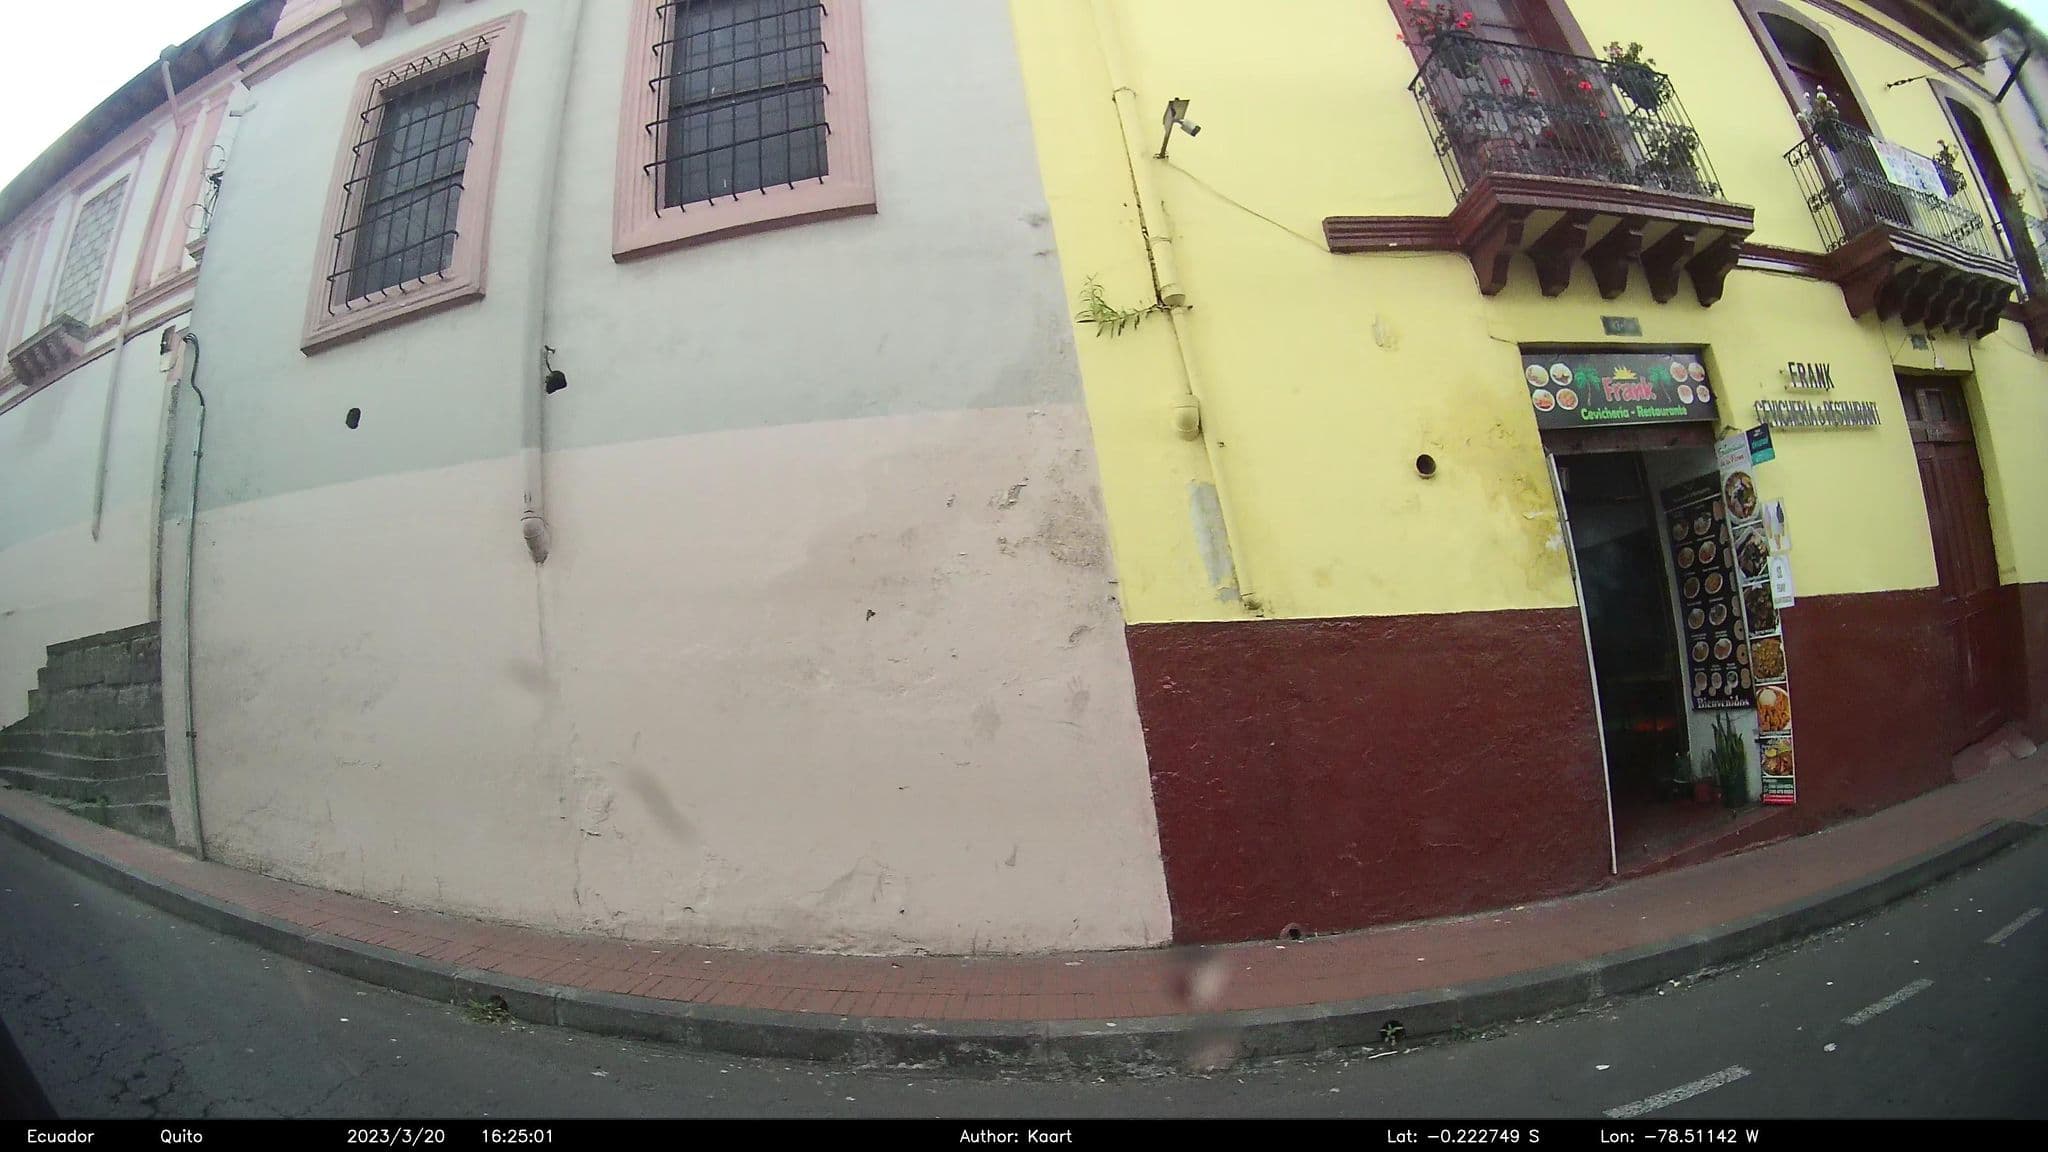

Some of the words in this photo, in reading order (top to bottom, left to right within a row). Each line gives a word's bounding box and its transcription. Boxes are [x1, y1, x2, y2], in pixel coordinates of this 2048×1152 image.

[1788, 361, 1834, 389] FRANK
[1602, 376, 1657, 402] Frank
[1636, 404, 1688, 418] Restaurante
[1697, 696, 1750, 709] Bienvenidos
